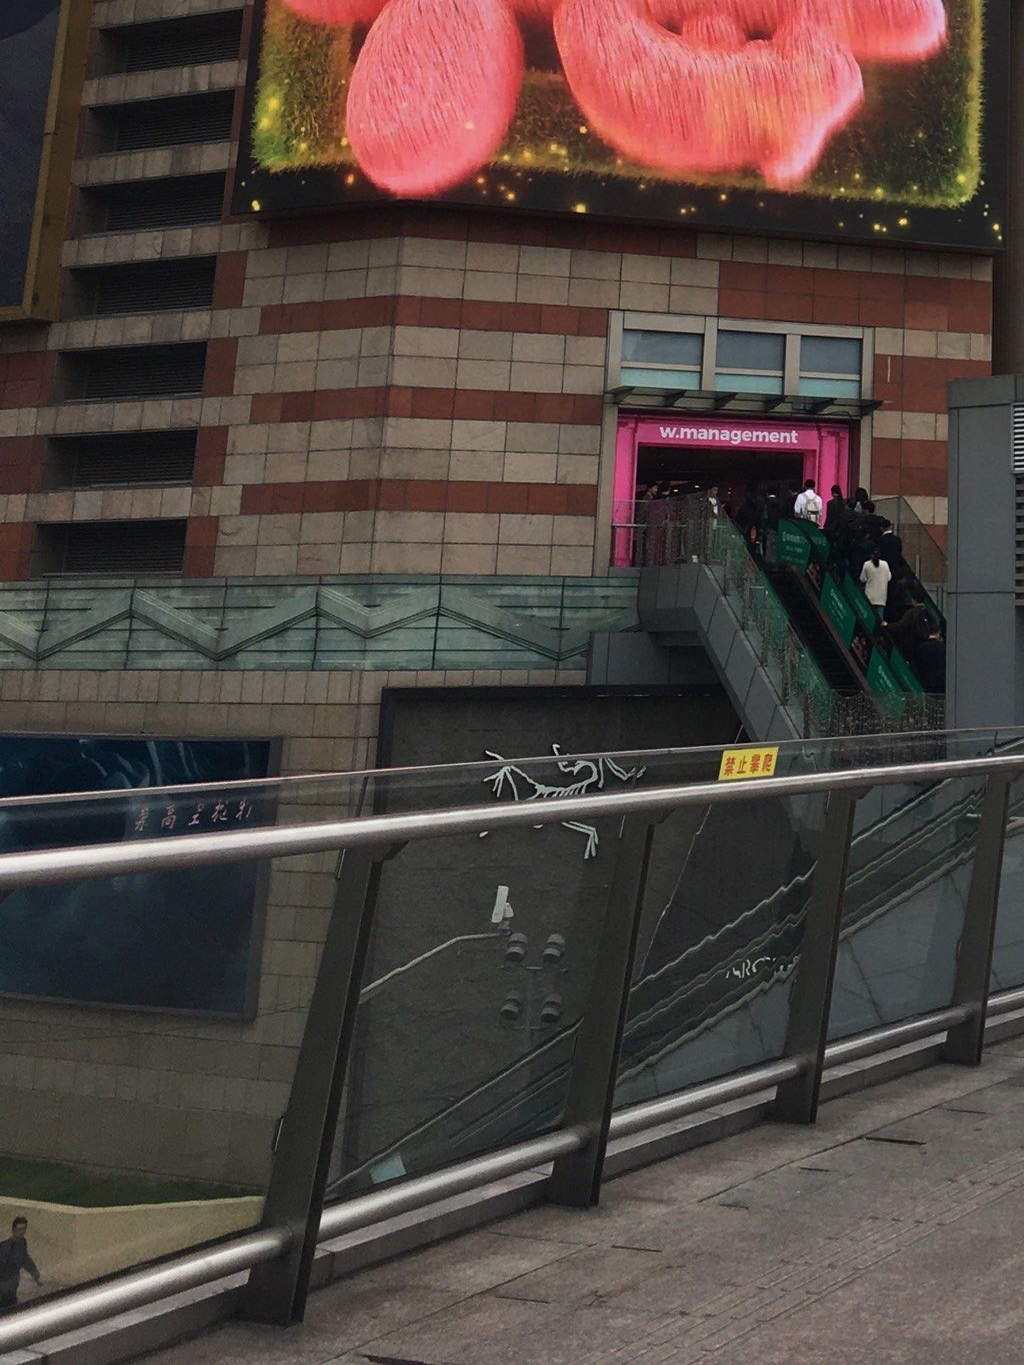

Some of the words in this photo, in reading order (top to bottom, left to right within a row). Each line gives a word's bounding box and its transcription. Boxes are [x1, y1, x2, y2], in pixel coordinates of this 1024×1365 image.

[659, 426, 799, 445] w.management
[723, 753, 773, 776] 禁止攀爬
